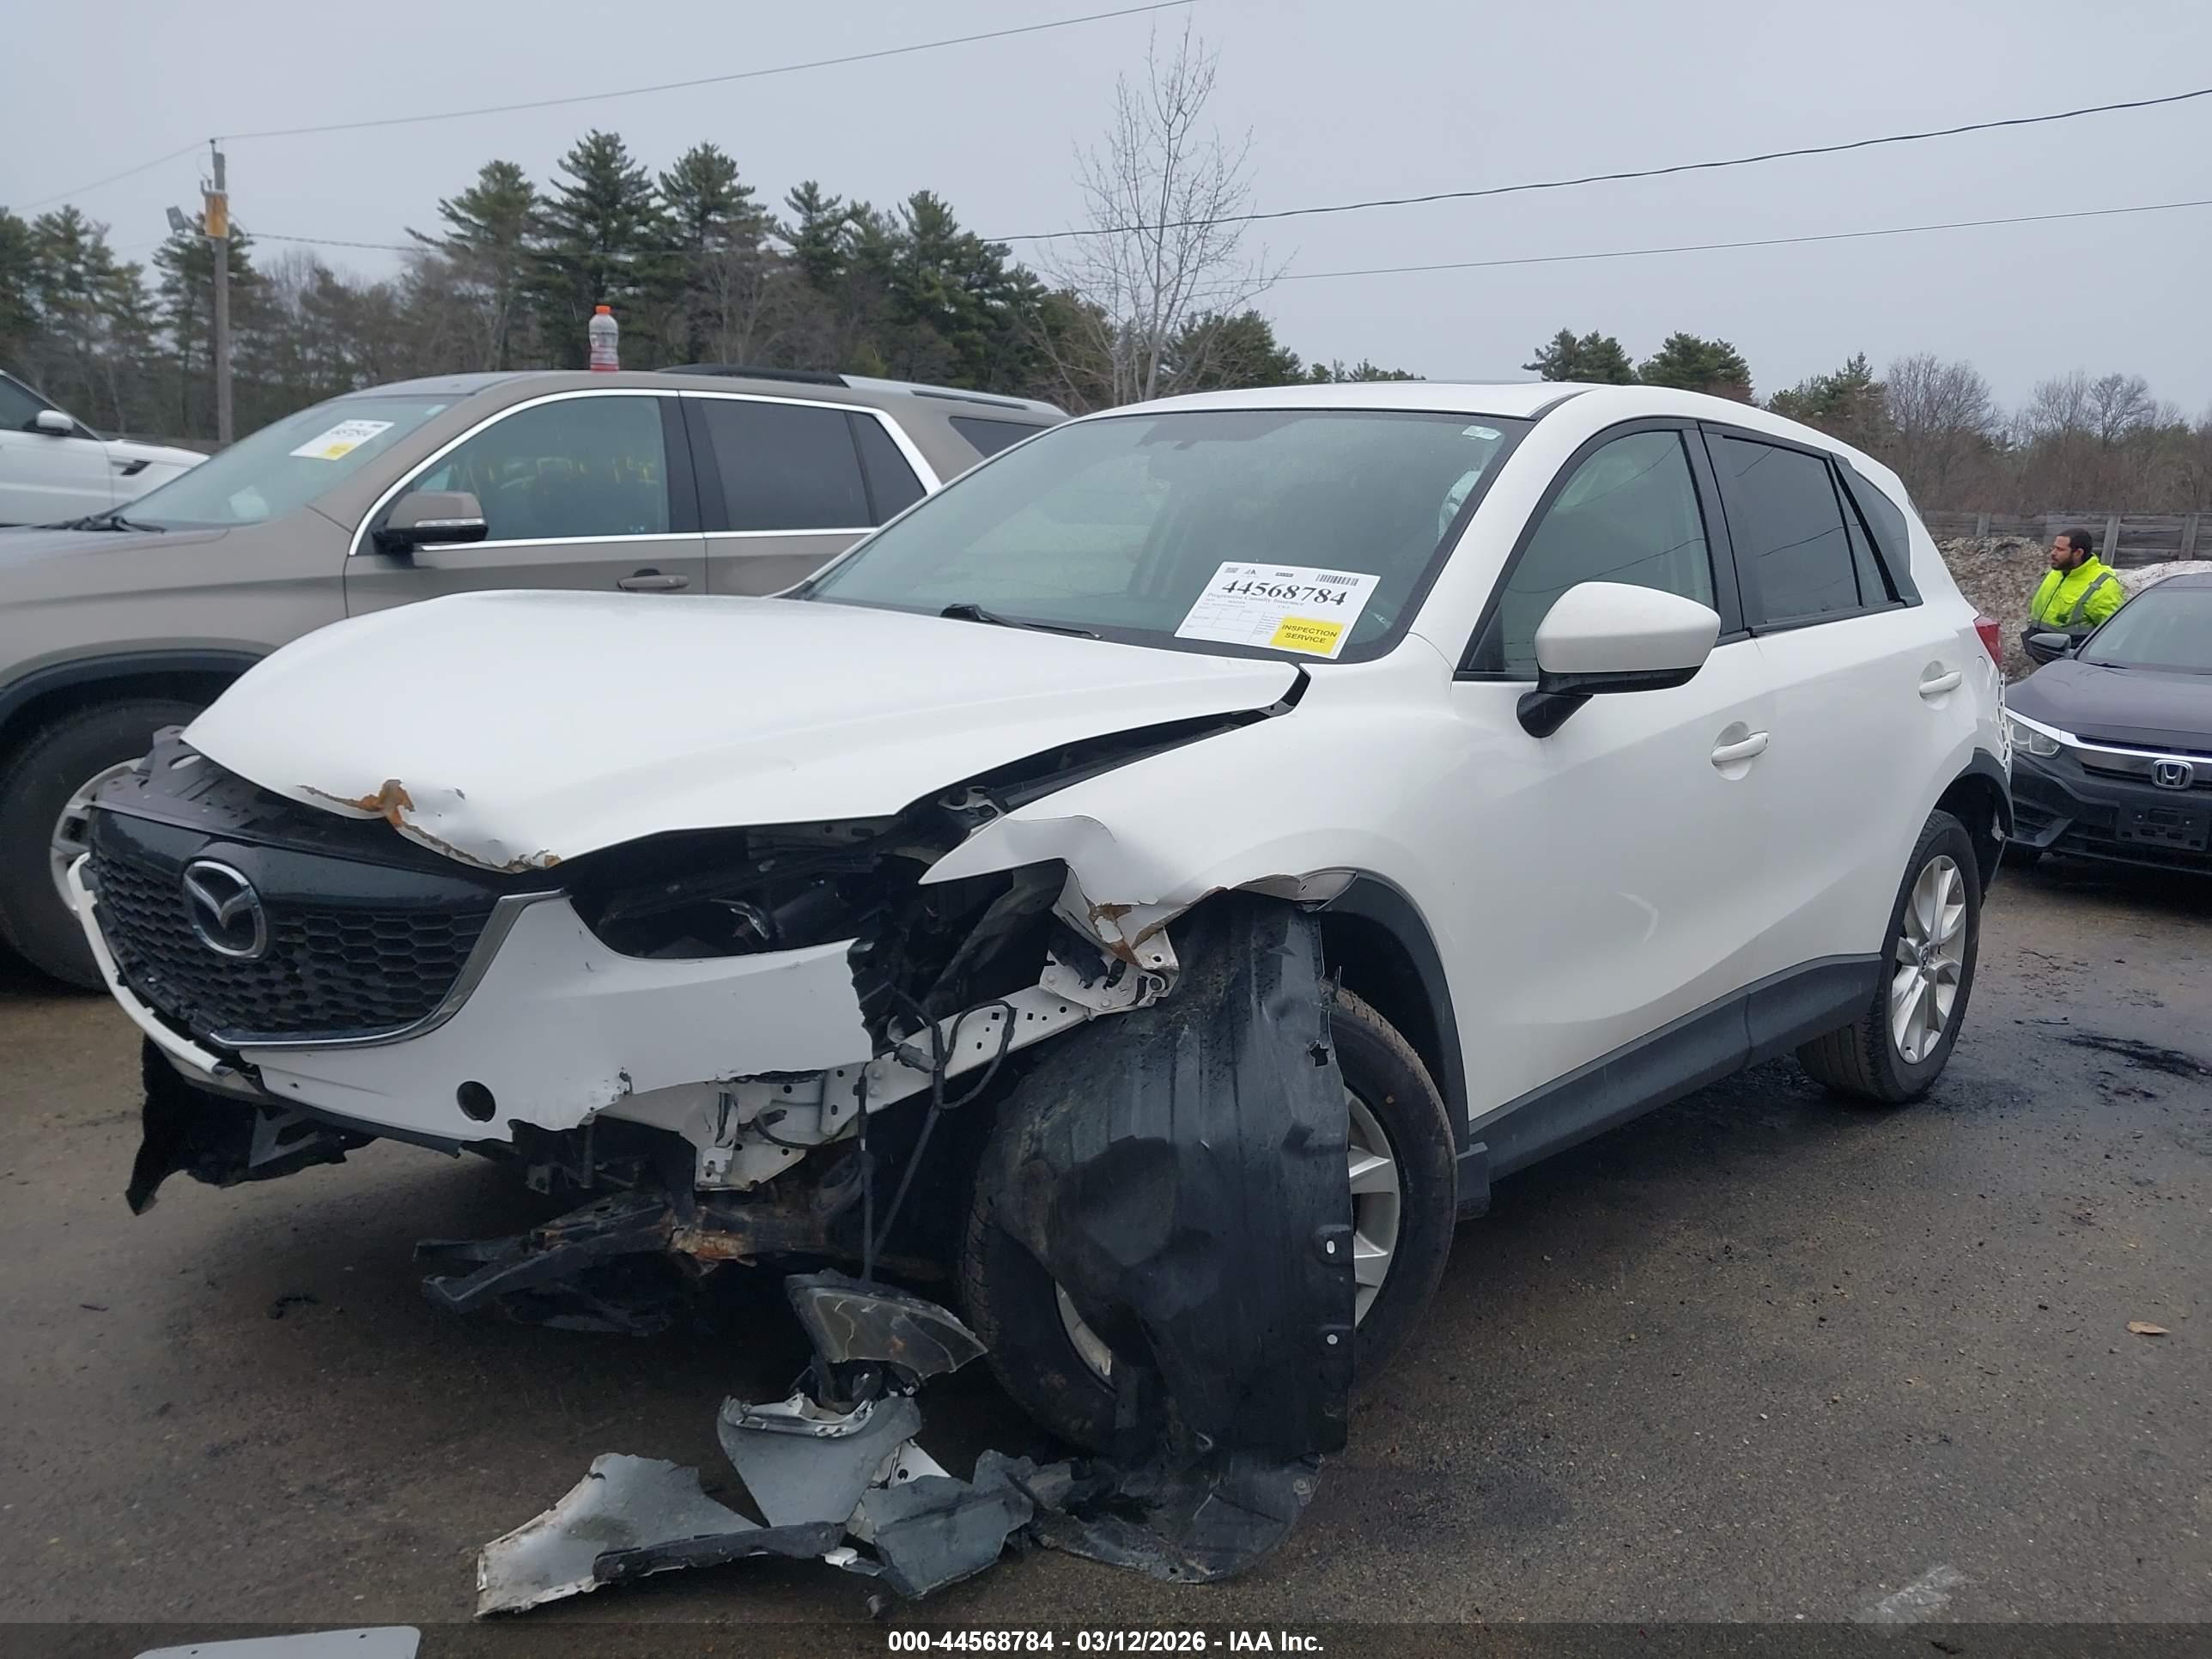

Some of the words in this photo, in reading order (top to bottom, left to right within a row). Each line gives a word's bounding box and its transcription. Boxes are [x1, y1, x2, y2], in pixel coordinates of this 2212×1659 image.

[1222, 580, 1347, 606] 44568784
[1282, 624, 1338, 638] INSPECTION
[1285, 633, 1327, 644] SERVICE
